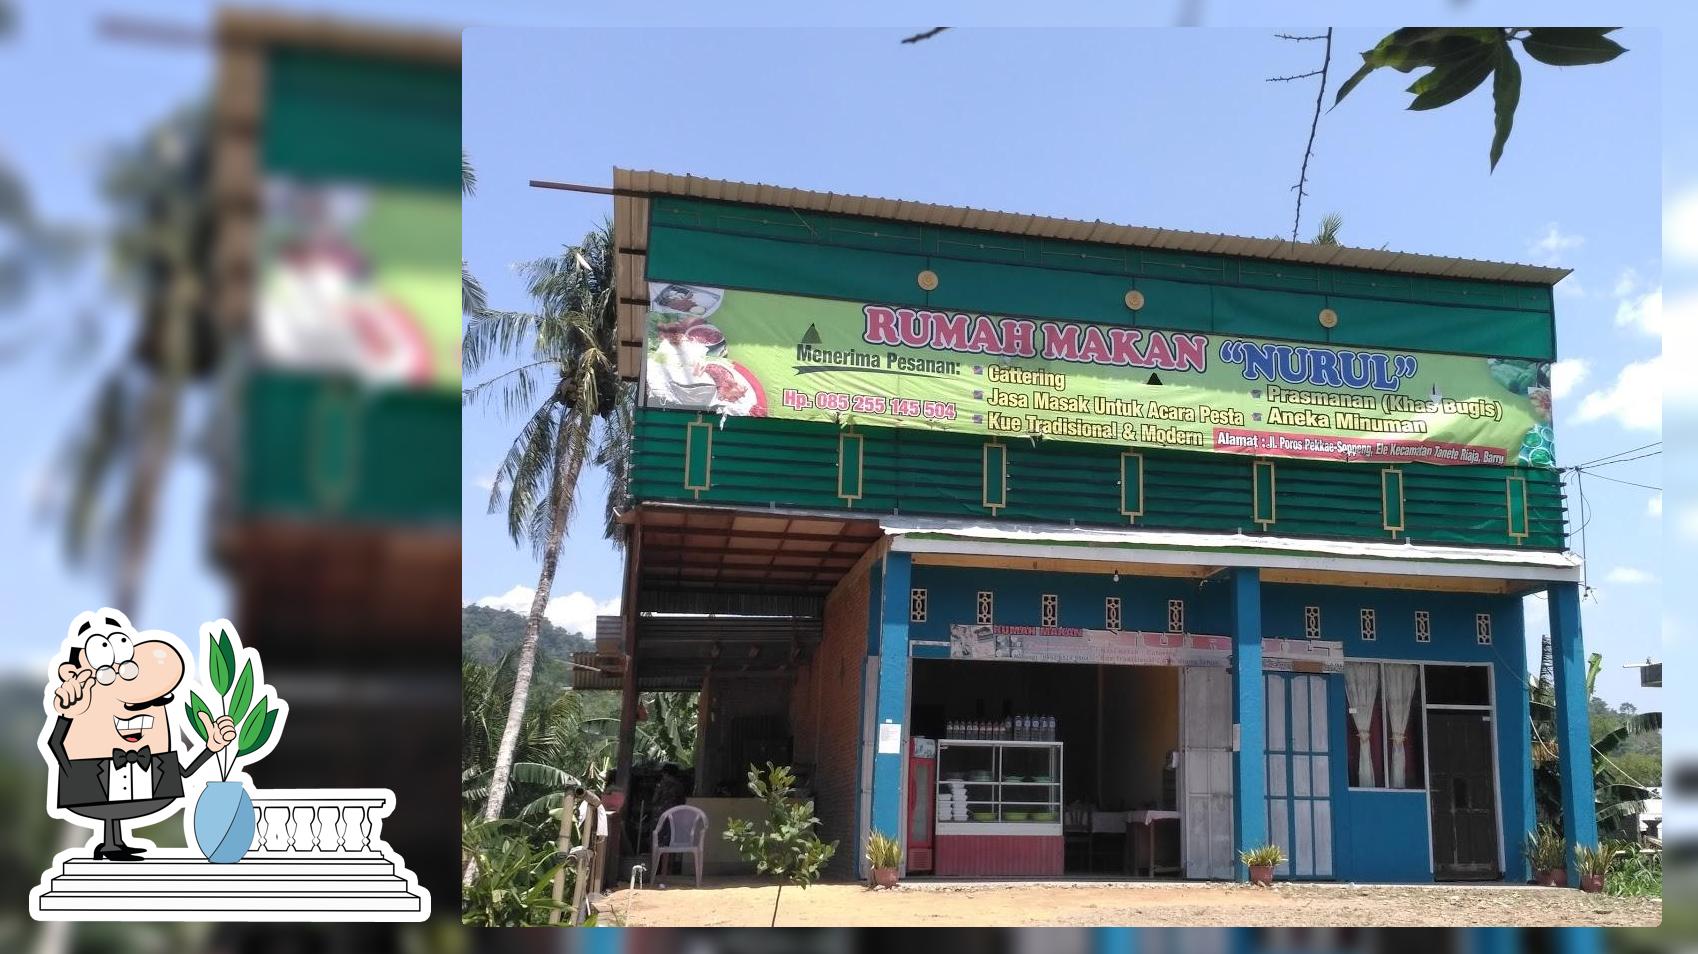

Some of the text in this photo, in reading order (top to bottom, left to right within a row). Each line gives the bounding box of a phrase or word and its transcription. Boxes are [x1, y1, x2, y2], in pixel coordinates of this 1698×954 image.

[796, 344, 961, 375] Menerima Pesanan:
[862, 304, 1418, 392] RUMAH MAKAN “NURUL”
[987, 364, 1066, 391] Cattering
[783, 388, 957, 420] Hp. 085 255 145 504
[987, 388, 1244, 426] Jasa Masak Untuk Acara Pesta
[1267, 385, 1503, 421] Prasmanan (Khas Bugis)
[987, 411, 1204, 446] Kue Tradisional & Modern
[1267, 407, 1427, 433] Aneka Minuman
[1217, 431, 1259, 448] Alamat
[1280, 436, 1303, 451] Poros
[1434, 446, 1459, 459] Tanete
[992, 625, 1084, 637] RUMAH MAKAN
